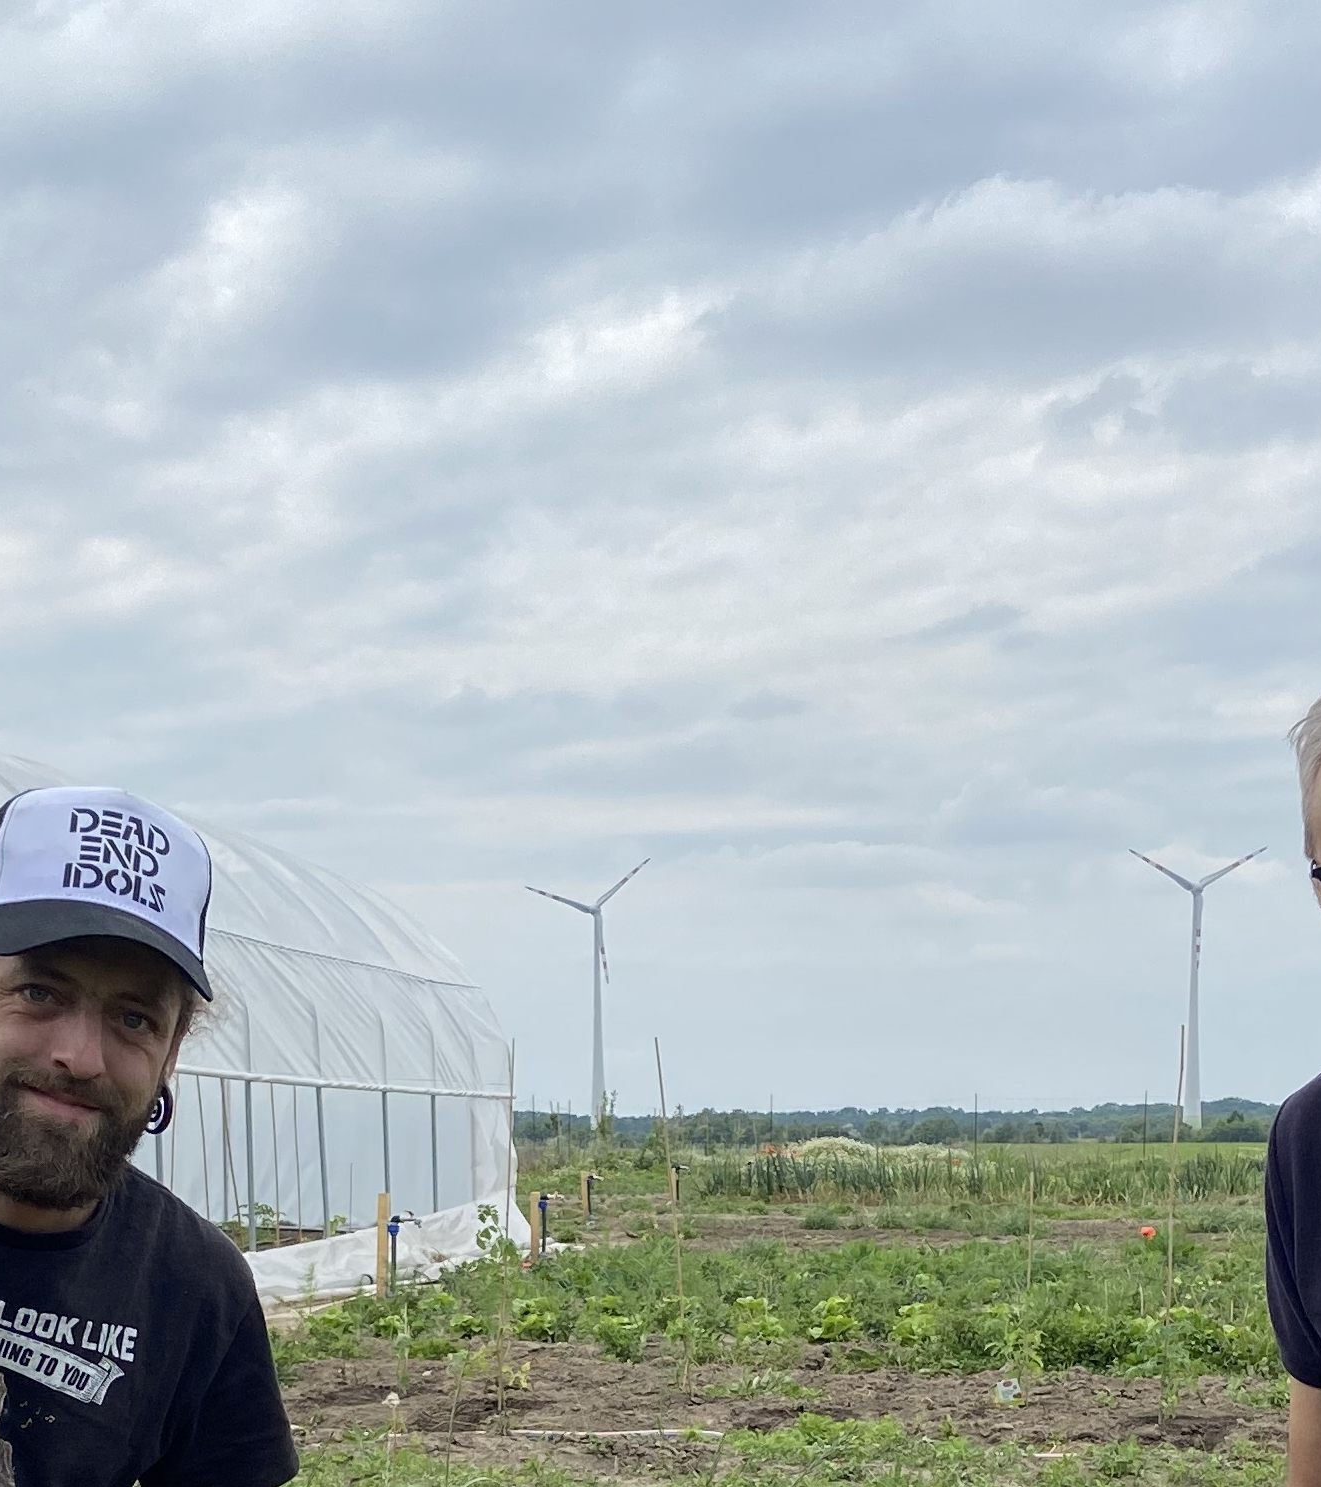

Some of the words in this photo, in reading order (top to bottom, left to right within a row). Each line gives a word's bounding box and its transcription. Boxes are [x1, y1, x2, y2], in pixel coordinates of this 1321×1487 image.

[69, 807, 170, 856] DEAD
[79, 836, 159, 878] END
[62, 862, 166, 913] IDOLS
[81, 1320, 138, 1363] LIKE
[35, 1352, 59, 1377] TO
[61, 1362, 91, 1392] YOU
